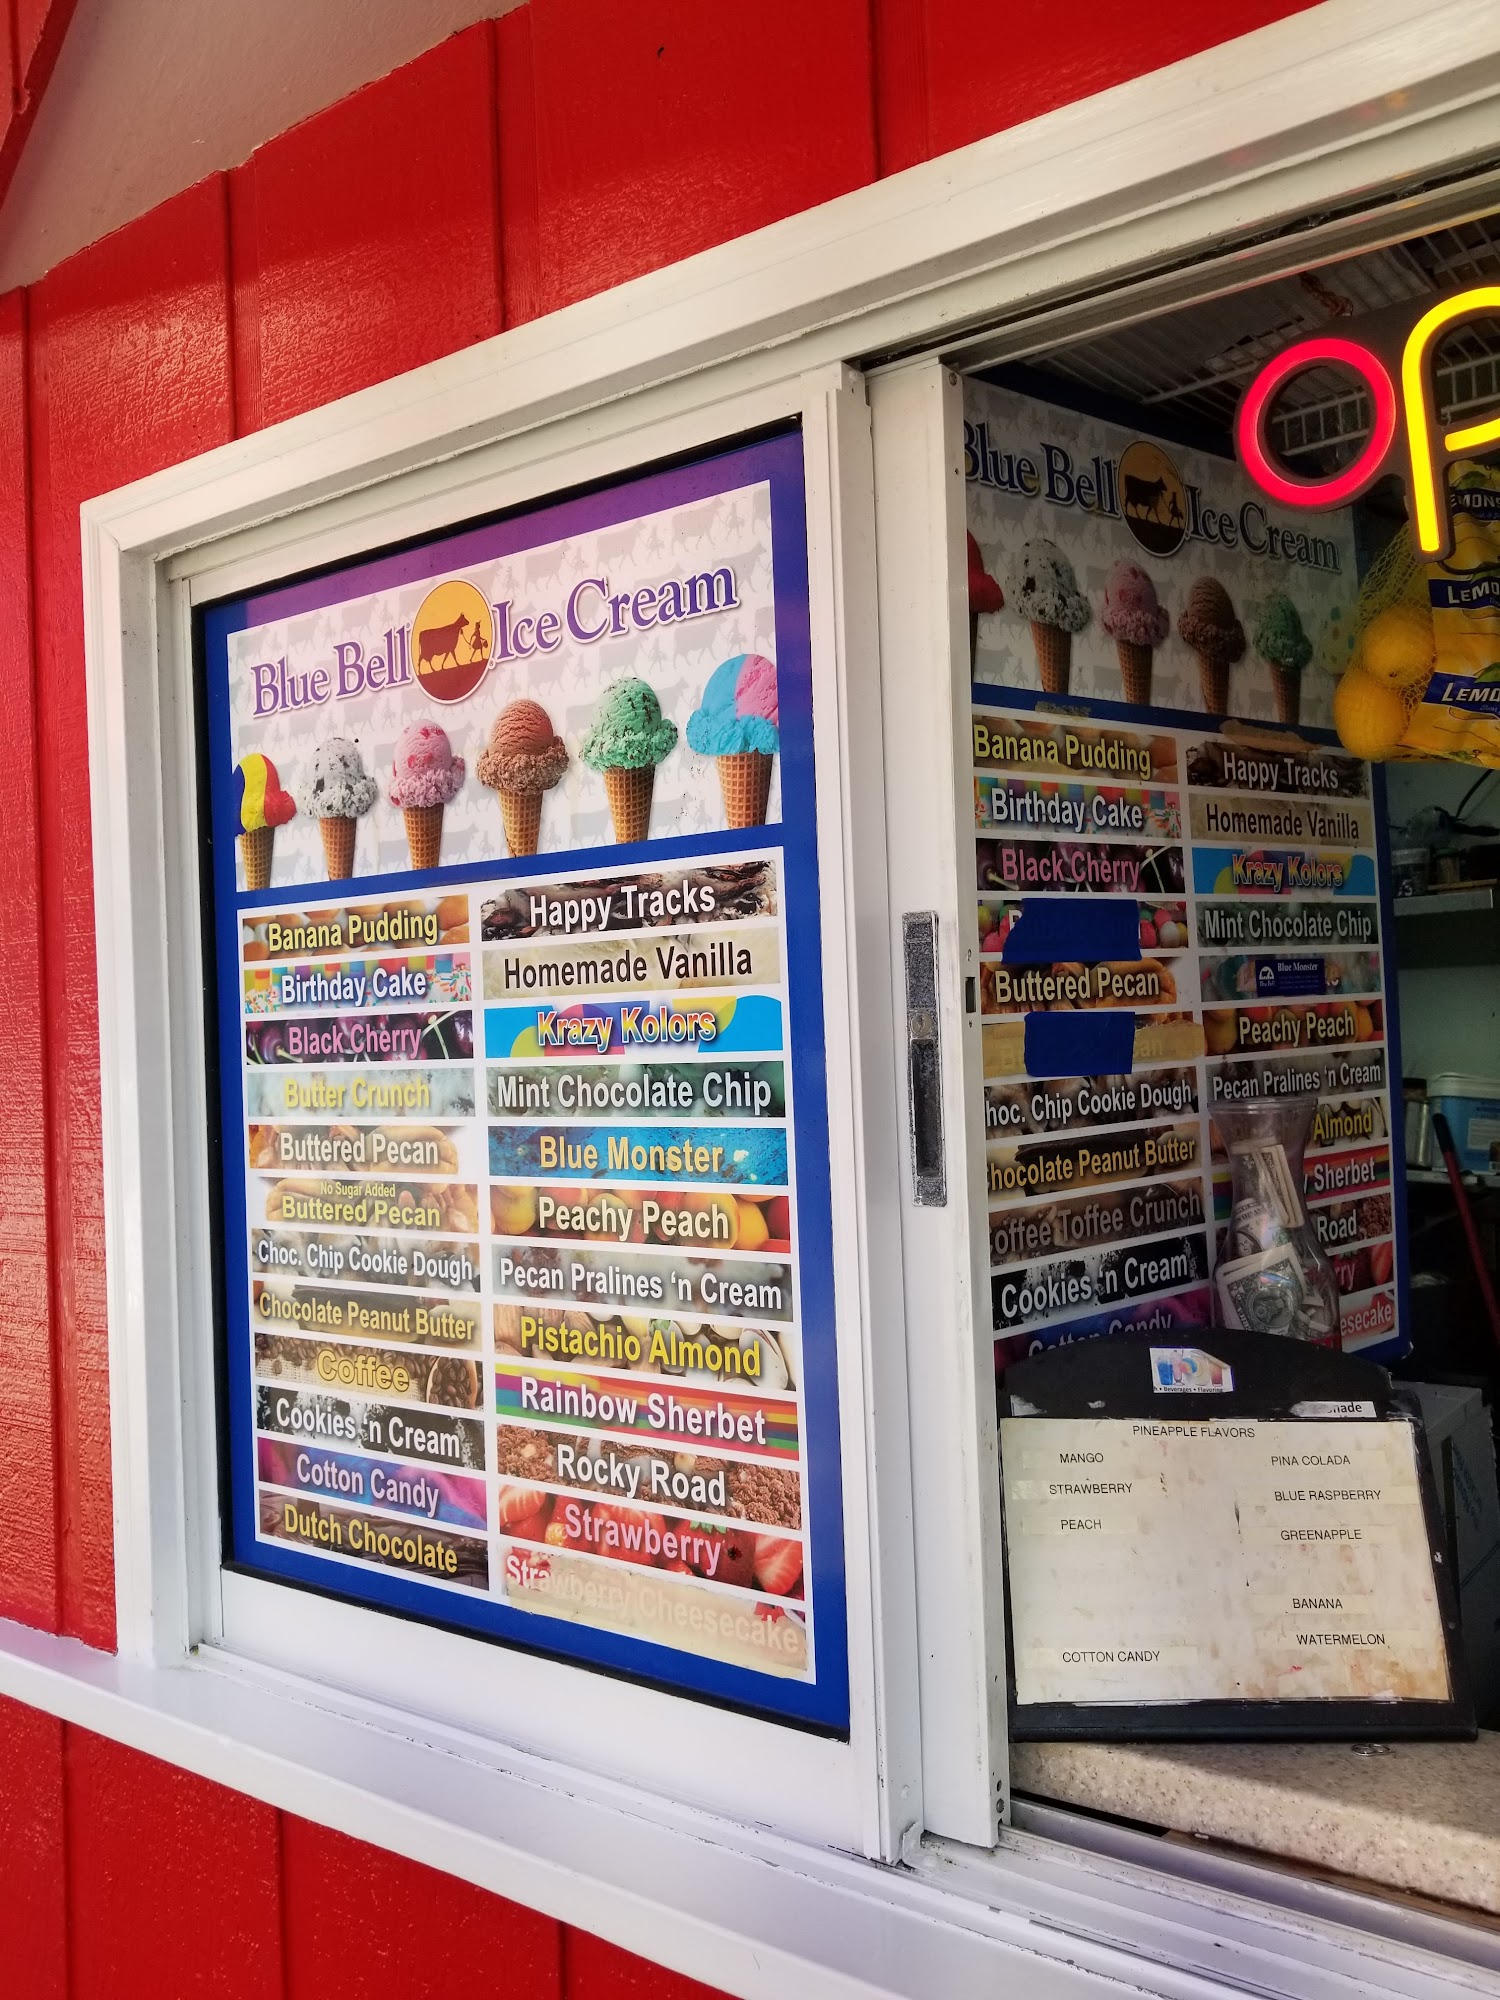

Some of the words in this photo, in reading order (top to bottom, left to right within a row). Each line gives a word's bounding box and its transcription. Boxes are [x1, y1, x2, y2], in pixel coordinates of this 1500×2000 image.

[1040, 441, 1121, 518] Bell
[1185, 486, 1238, 541] Ice
[1239, 501, 1341, 572] Cream
[251, 661, 329, 716] Blue
[334, 623, 411, 696] Bell
[492, 600, 562, 659] Ice
[565, 567, 740, 641] Cream
[973, 724, 1059, 764] Banana
[1065, 734, 1151, 780] Pudding
[1223, 752, 1280, 790] Happy
[1283, 757, 1339, 789] Tracks
[991, 787, 1086, 830] Birthday
[1092, 795, 1144, 828] Cake
[1206, 804, 1303, 836] Homemade
[1306, 810, 1360, 839] Vanilla
[1002, 848, 1067, 882] Black
[1071, 851, 1140, 889] Cherry
[1232, 854, 1283, 892] Krazy
[1287, 856, 1343, 887] Kolors
[529, 893, 613, 934] Happy
[620, 879, 716, 919] Tracks
[268, 922, 342, 951] Banana
[348, 909, 438, 945] Pudding
[1204, 910, 1243, 939] Mint
[1248, 910, 1332, 939] Chocolate
[1336, 911, 1372, 944] Chip
[504, 949, 648, 989] Homemade
[655, 941, 753, 980] Vanilla
[1277, 962, 1292, 972] Blue
[1293, 962, 1318, 972] Monster
[281, 969, 366, 1006] Birthday
[372, 967, 427, 997] Cake
[995, 968, 1091, 1003] Buttered
[1097, 967, 1159, 998] Pecan
[289, 1024, 344, 1055] Black
[350, 1023, 422, 1059] Cherry
[537, 1011, 613, 1053] Krazy
[620, 1006, 717, 1043] Kolors
[1239, 1013, 1303, 1047] Peachy
[1306, 1012, 1355, 1040] Peach
[284, 1078, 345, 1107] Butter
[352, 1077, 430, 1107] Crunch
[497, 1075, 550, 1107] Mint
[557, 1073, 693, 1108] Chocolate
[702, 1072, 772, 1116] Chip
[1212, 1074, 1261, 1101] Pecan
[1263, 1066, 1321, 1098] Pralines
[1340, 1062, 1382, 1087] Cream
[985, 1101, 1027, 1127] hoc.
[1031, 1093, 1073, 1124] Chip
[1077, 1087, 1136, 1115] Cookie
[1140, 1079, 1192, 1110] Dough
[1313, 1107, 1373, 1140] Almond
[280, 1133, 365, 1163] Buttered
[372, 1134, 439, 1165] Pecan
[539, 1135, 598, 1169] Blue
[607, 1136, 724, 1172] Monster
[987, 1155, 1073, 1191] hocolate
[1078, 1143, 1141, 1177] Peanut
[1144, 1138, 1195, 1167] Butter
[320, 1181, 332, 1196] No
[335, 1182, 362, 1199] Sugar
[363, 1183, 396, 1198] Added
[1314, 1157, 1376, 1191] Sherbet
[281, 1197, 368, 1223] Buttered
[374, 1201, 441, 1227] Pecan
[538, 1196, 633, 1241] Peachy
[642, 1200, 729, 1239] Peach
[989, 1217, 1051, 1255] offee
[1057, 1204, 1124, 1242] Toffee
[1129, 1187, 1201, 1228] Crunch
[1317, 1209, 1358, 1243] Road
[257, 1242, 301, 1267] Choc.
[307, 1243, 344, 1274] Chip
[348, 1247, 408, 1275] Cookie
[412, 1252, 474, 1286] Dough
[500, 1257, 564, 1291] Pecan
[570, 1262, 663, 1300] Pralines
[700, 1272, 783, 1310] Cream
[1001, 1266, 1092, 1318] Cookies
[1124, 1253, 1188, 1289] Cream
[259, 1291, 342, 1325] Chocolate
[347, 1300, 411, 1333] Peanut
[415, 1307, 475, 1341] Butter
[520, 1315, 641, 1362] Pistachio
[648, 1327, 762, 1377] Almond
[317, 1349, 411, 1393] Coffee
[276, 1397, 356, 1439] Cookies
[388, 1416, 461, 1459] Cream
[520, 1376, 637, 1426] Rainbow
[647, 1393, 767, 1446] Sherbet
[1133, 1425, 1197, 1437] PINEAPPLE
[1200, 1427, 1256, 1438] FLAVORS
[557, 1443, 641, 1498] Rocky
[651, 1460, 727, 1507] Road
[1059, 1452, 1104, 1464] MANGO
[1271, 1455, 1299, 1466] PINA
[1301, 1455, 1351, 1466] COLADA
[296, 1453, 364, 1495] Cotton
[370, 1467, 440, 1518] Candy
[1049, 1483, 1133, 1495] STRAWBERRY
[1274, 1491, 1306, 1501] BLUE
[1308, 1490, 1381, 1501] RASPBERRY
[284, 1503, 342, 1545] Dutch
[348, 1519, 458, 1574] Chocolate
[564, 1503, 722, 1577] Strawberry
[1060, 1519, 1102, 1530] PEACH
[1280, 1530, 1362, 1541] GREENAPPLE
[505, 1554, 632, 1612] Strawberry
[637, 1587, 800, 1652] Cheesecake
[1292, 1599, 1343, 1609] BANANA
[1062, 1651, 1114, 1663] COTTON
[1117, 1651, 1160, 1663] CANDY
[1296, 1634, 1386, 1646] WATERMELON
